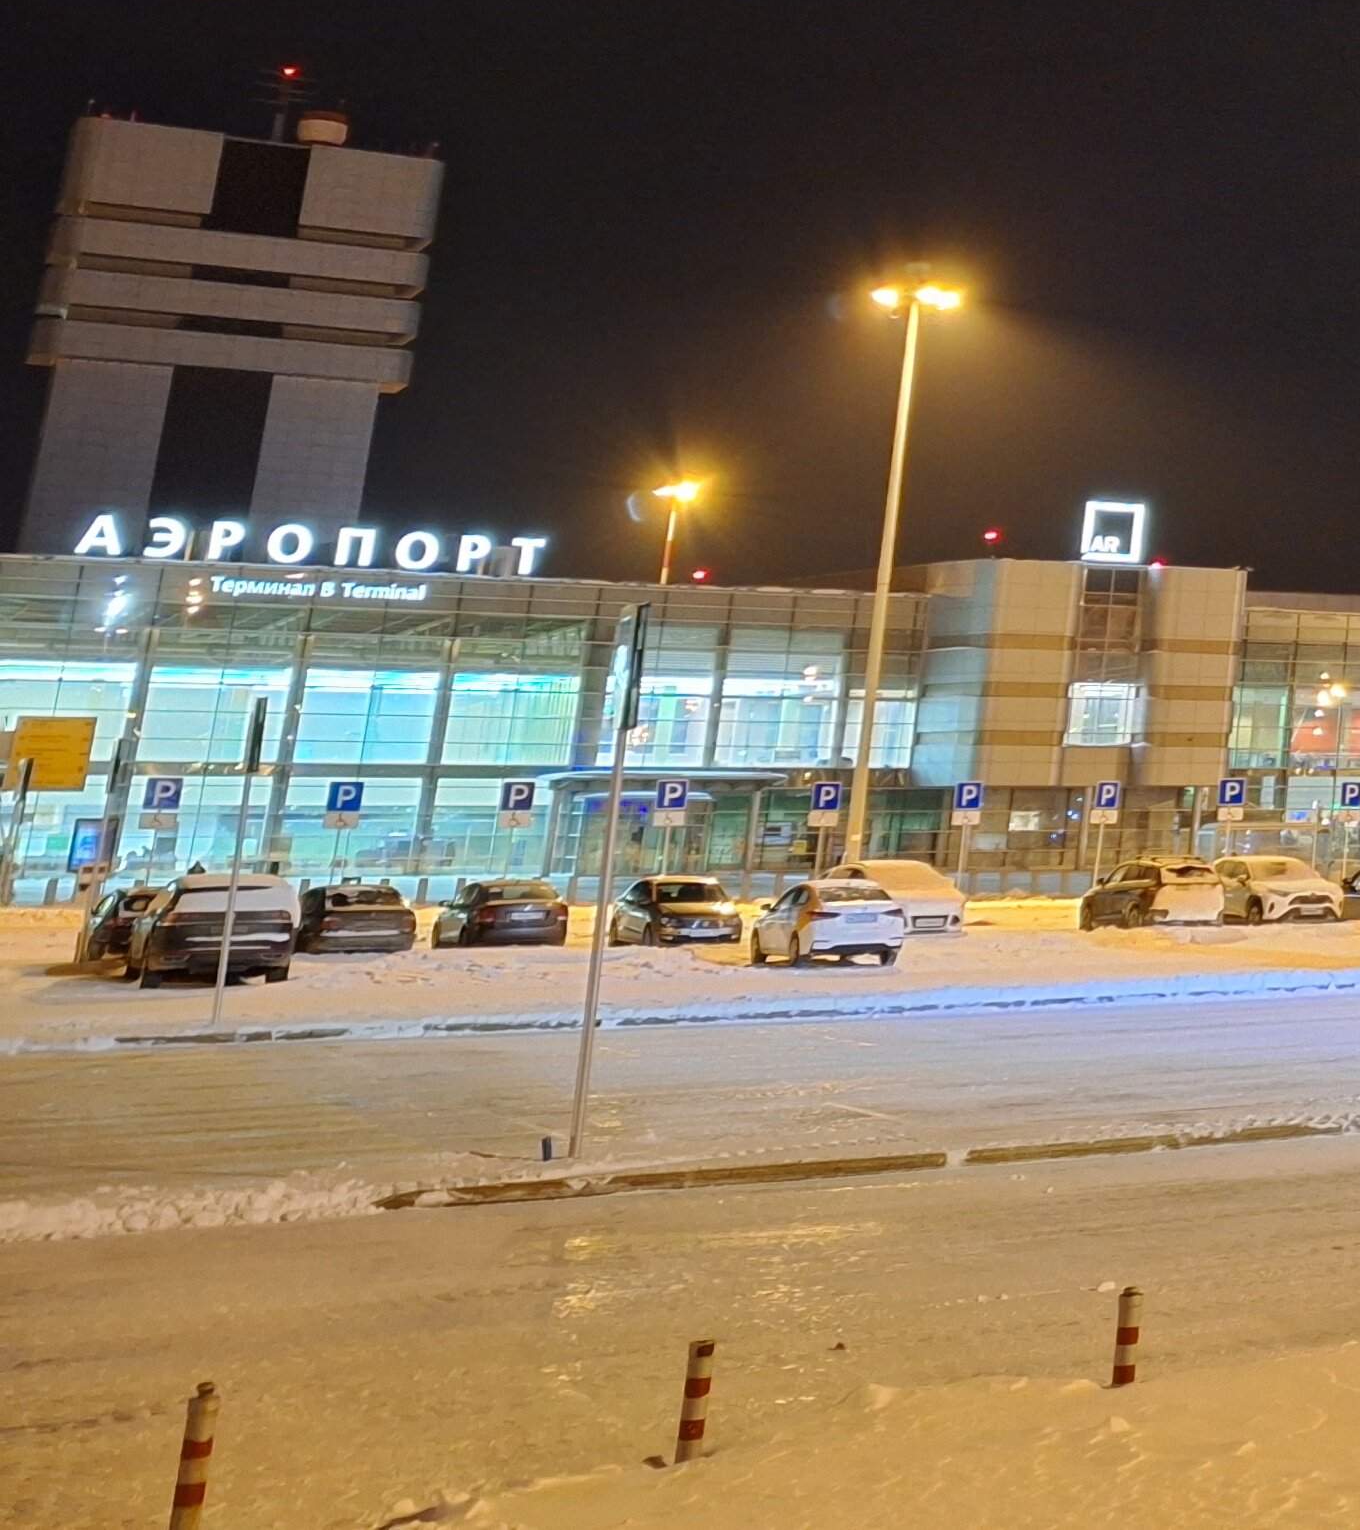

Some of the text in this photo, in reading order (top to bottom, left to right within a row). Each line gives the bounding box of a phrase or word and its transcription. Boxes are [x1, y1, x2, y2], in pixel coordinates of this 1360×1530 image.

[74, 515, 546, 575] АЭРОПОРТ
[1090, 535, 1120, 553] AR
[211, 576, 315, 596] Терминал
[341, 582, 427, 600] Terminal
[152, 781, 176, 806] P
[337, 786, 356, 808] P
[509, 785, 528, 808] P
[664, 784, 682, 806] P
[819, 786, 836, 808] P
[962, 786, 977, 807] P
[1100, 785, 1115, 806] P
[1225, 783, 1240, 804] P
[1345, 785, 1358, 805] P
